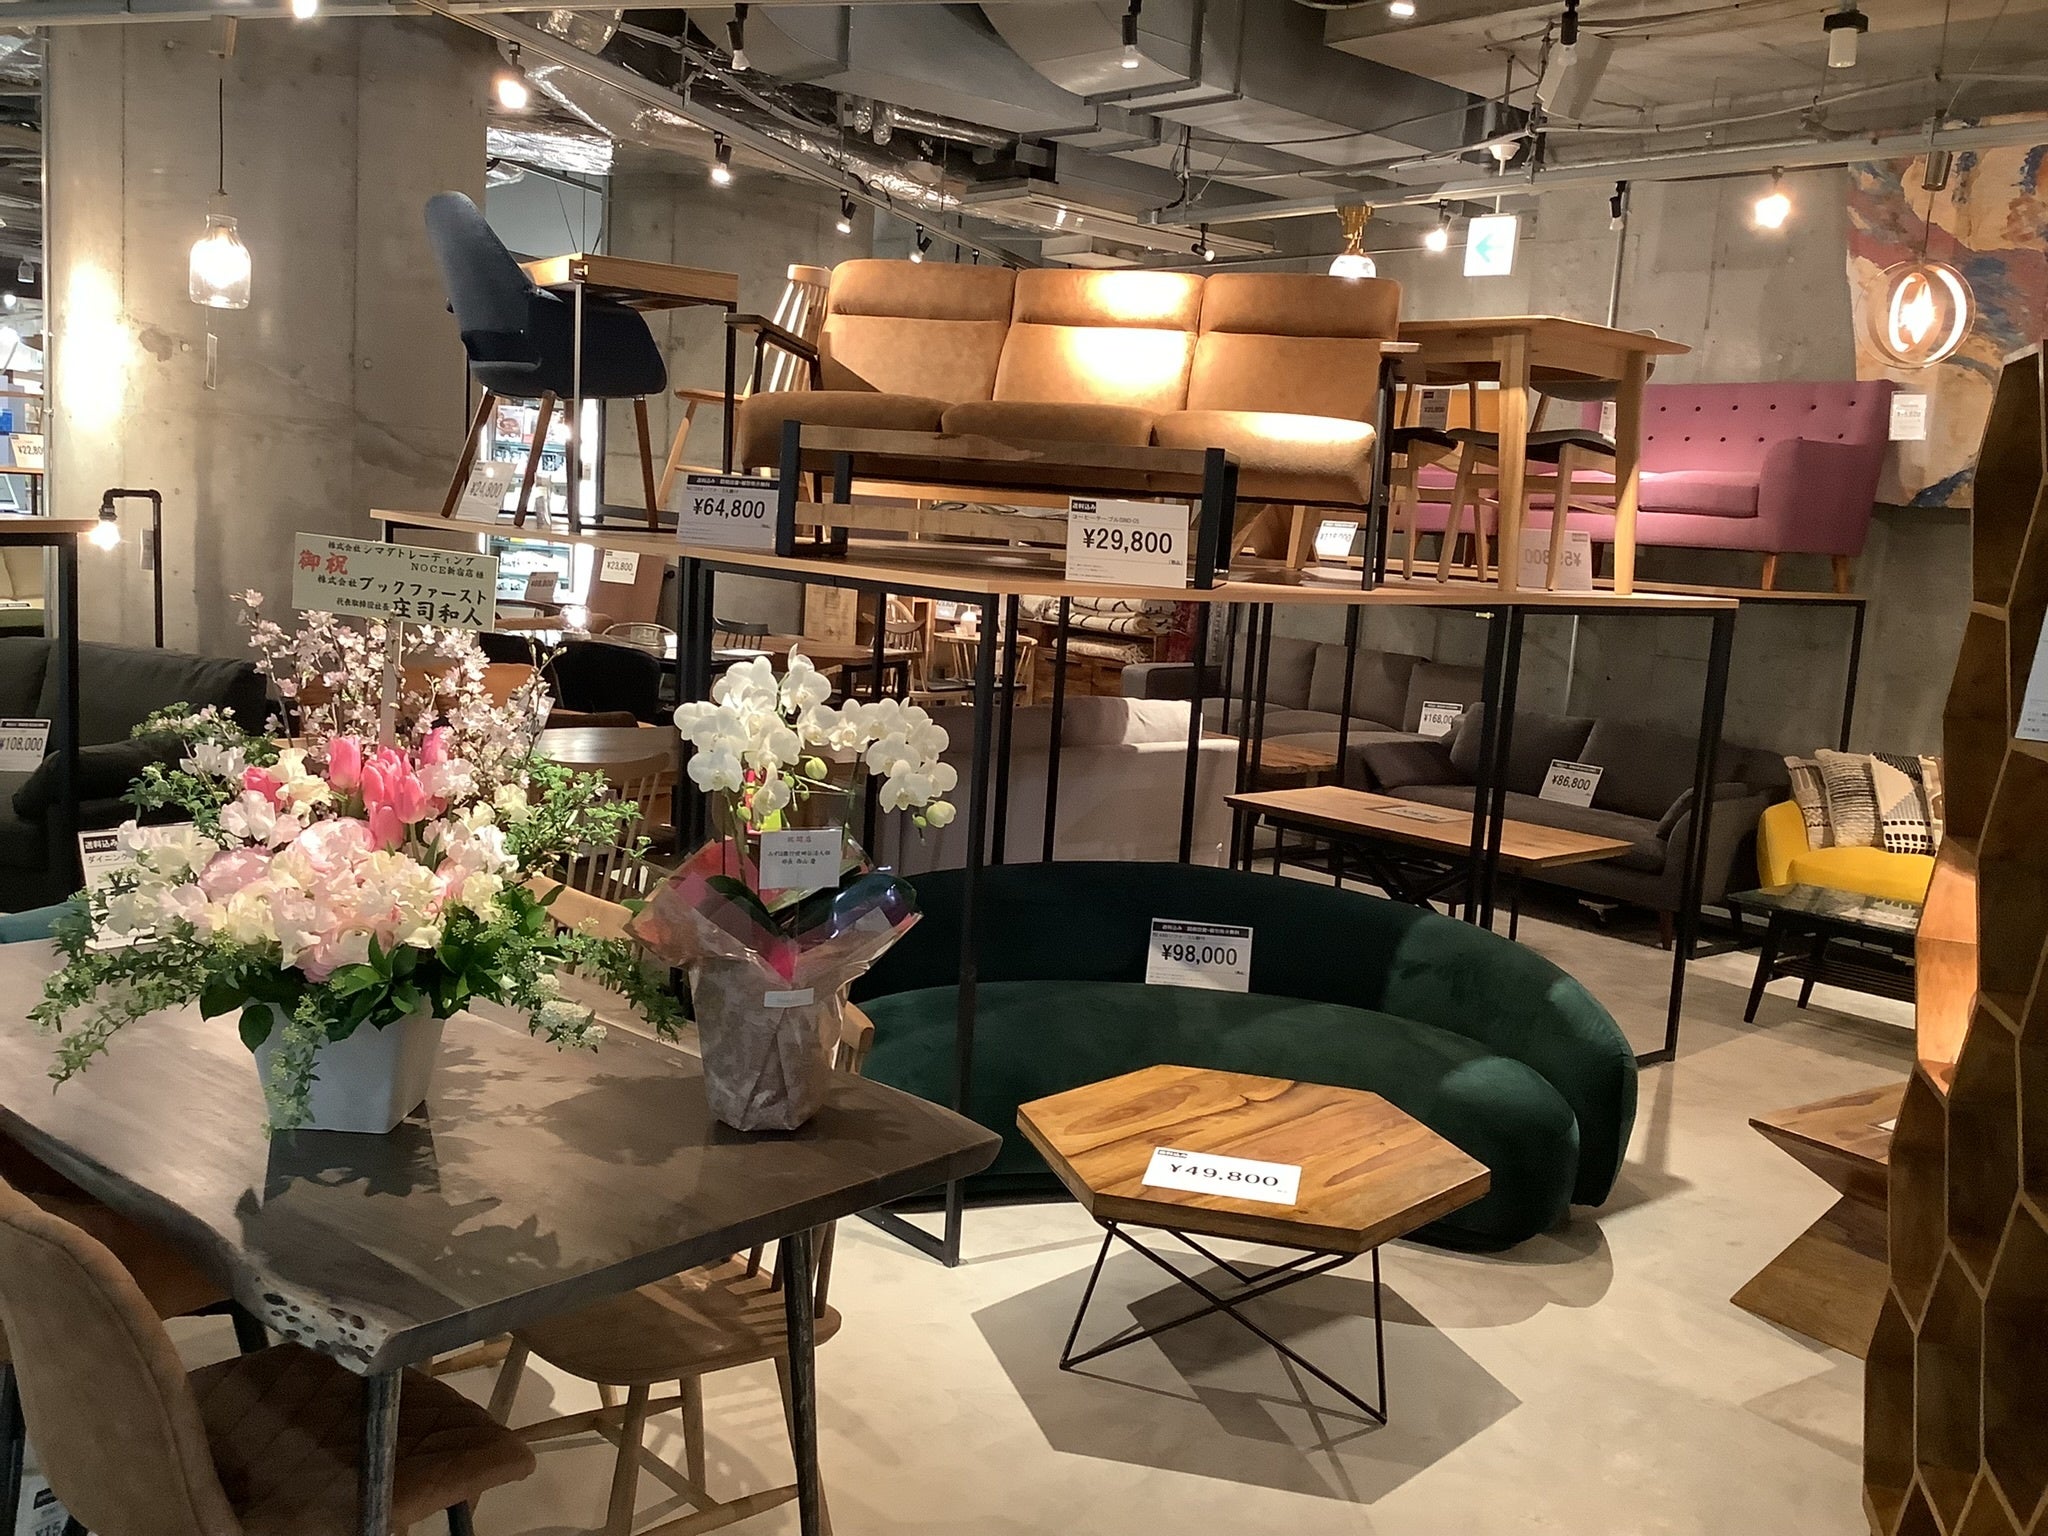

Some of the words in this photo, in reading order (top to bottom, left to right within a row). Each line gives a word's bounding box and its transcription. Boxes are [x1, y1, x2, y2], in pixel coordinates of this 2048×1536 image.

[693, 497, 765, 519] ¥64,800
[1083, 527, 1172, 554] ¥29,800
[299, 549, 349, 576] 御祝
[1424, 713, 1453, 724] ¥168,00
[1552, 773, 1591, 791] ¥86,800
[1161, 944, 1238, 966] ¥98,000
